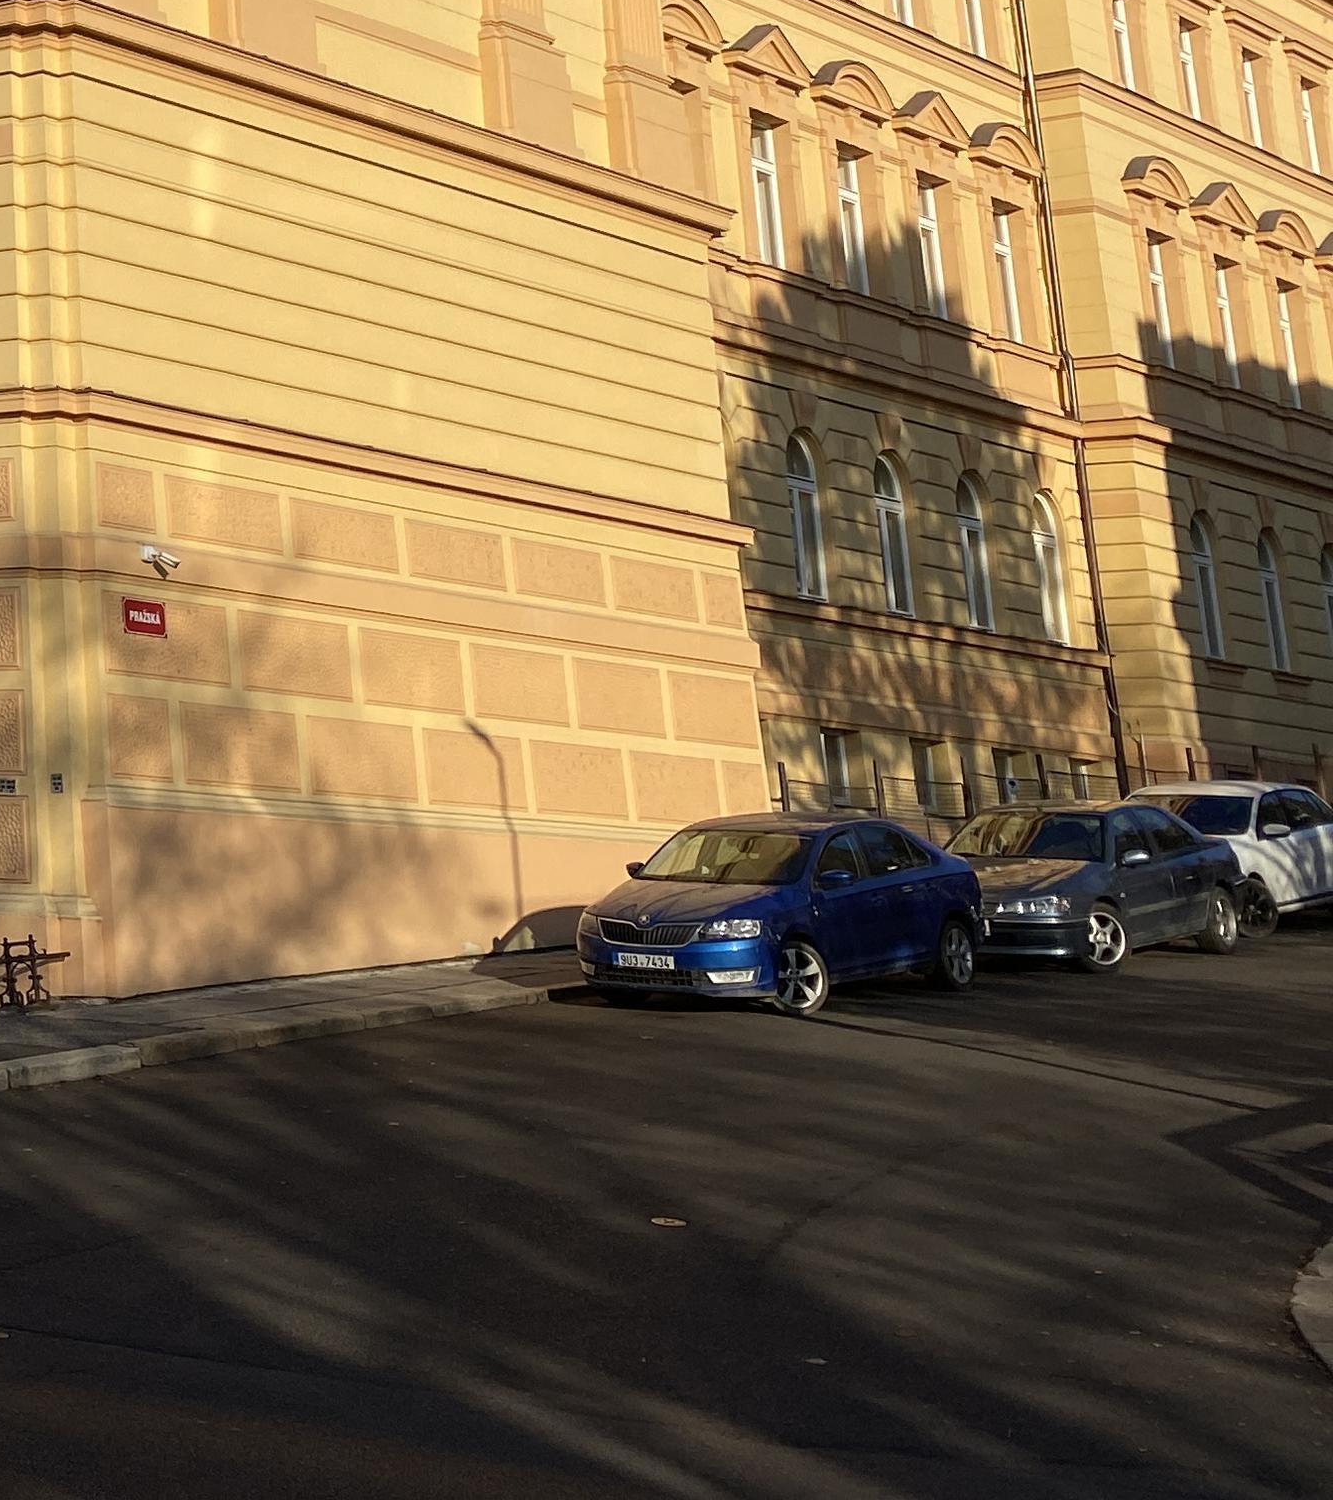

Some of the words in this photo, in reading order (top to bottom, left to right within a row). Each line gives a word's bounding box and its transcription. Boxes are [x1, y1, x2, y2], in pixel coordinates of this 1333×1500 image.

[129, 609, 161, 625] PRAŽSKÁ
[620, 954, 639, 966] 9U3
[645, 956, 670, 968] 7434
